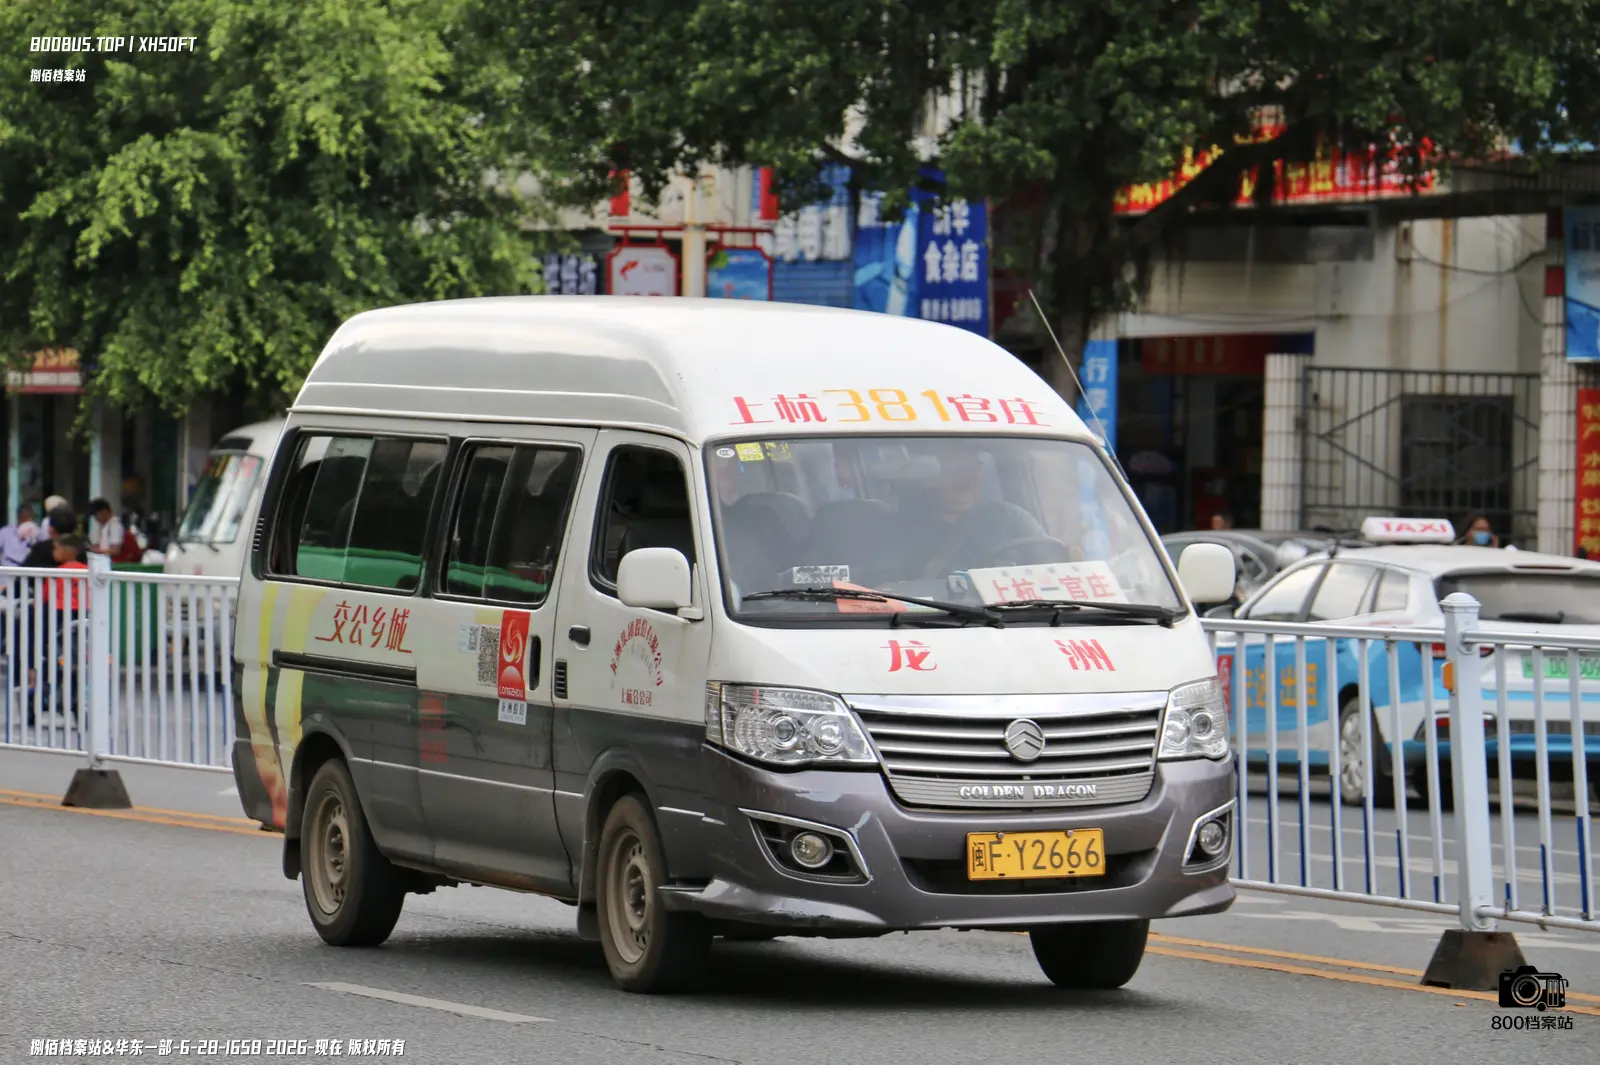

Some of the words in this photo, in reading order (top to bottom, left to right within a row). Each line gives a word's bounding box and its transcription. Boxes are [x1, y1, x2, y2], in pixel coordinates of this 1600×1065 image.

[1383, 521, 1448, 533] TAXI
[621, 688, 652, 707] 上杭分公司
[959, 785, 1025, 800] GOLDEN
[1032, 784, 1097, 800] DRAGON
